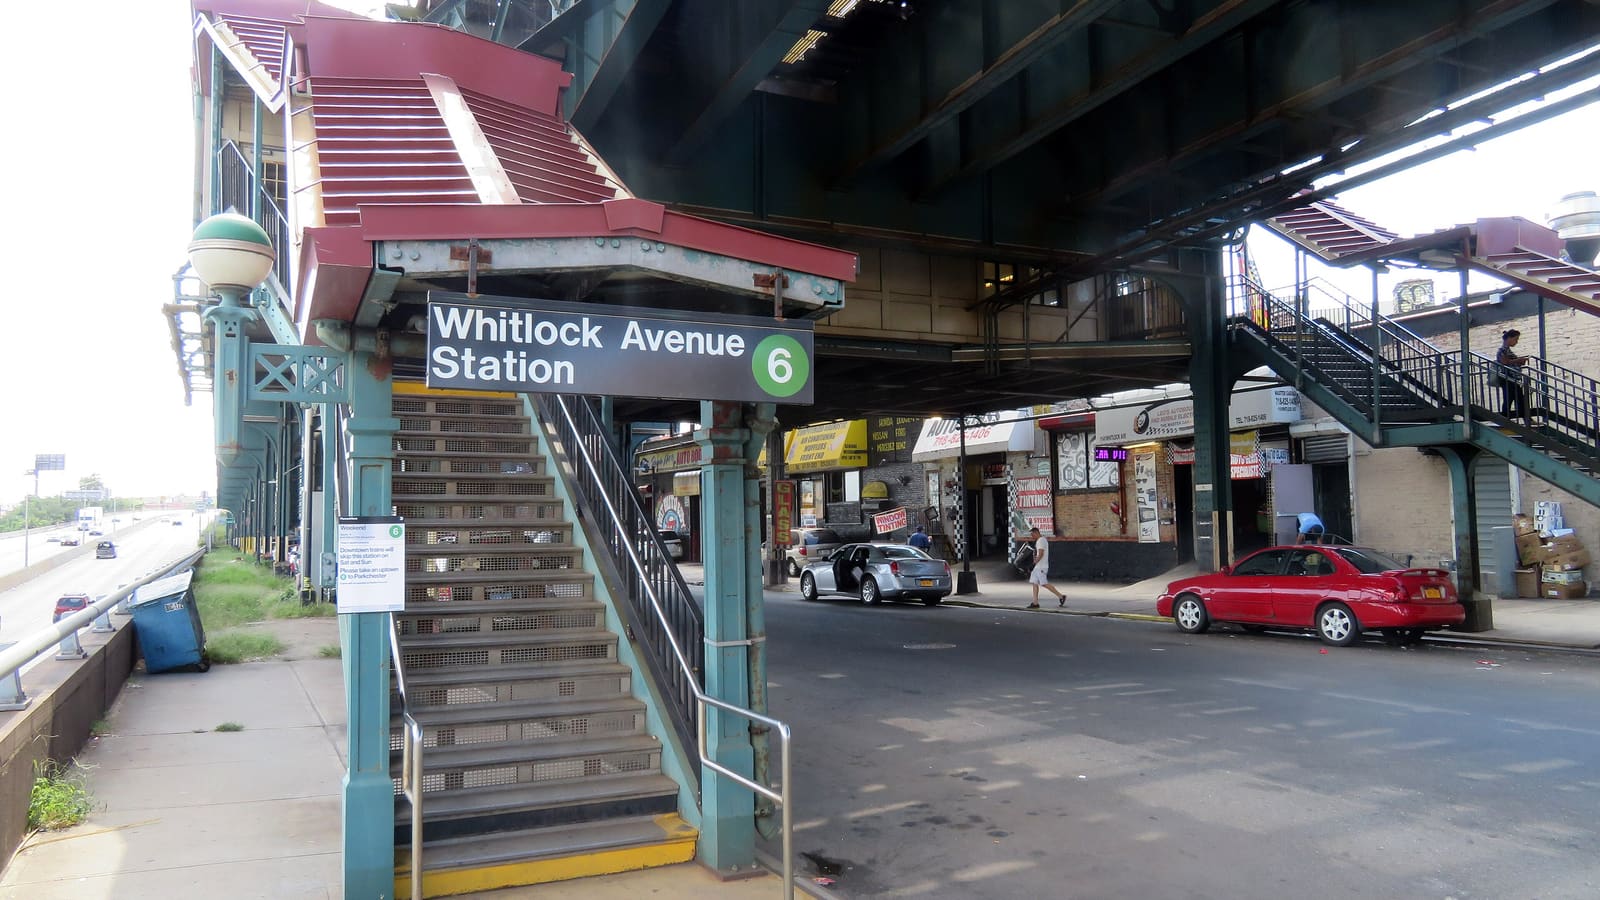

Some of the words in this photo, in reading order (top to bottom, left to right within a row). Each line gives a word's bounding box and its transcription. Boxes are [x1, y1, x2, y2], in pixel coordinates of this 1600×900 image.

[433, 306, 602, 349] Whitlock
[620, 320, 746, 358] Avenue
[432, 345, 575, 385] Station
[767, 347, 793, 384] 6
[676, 450, 691, 465] AUTO
[776, 482, 790, 543] GLASS
[1018, 494, 1048, 507] TINTING
[876, 510, 905, 524] WINDOW
[878, 518, 907, 532] TINTING
